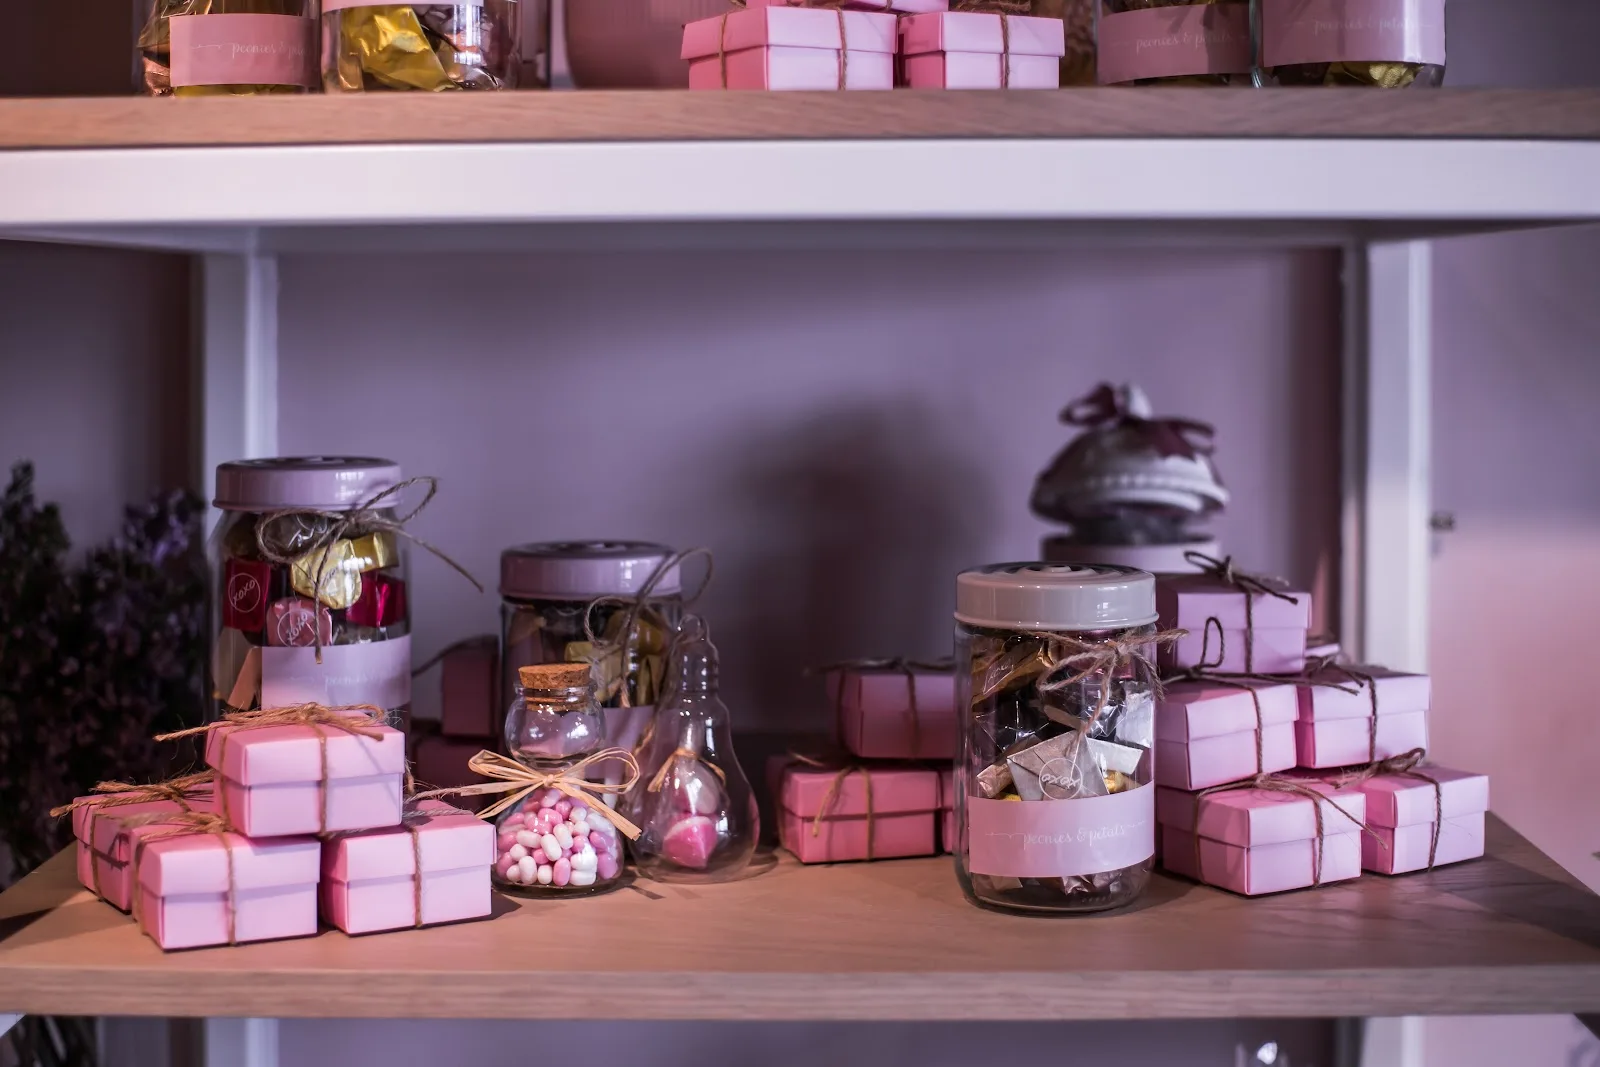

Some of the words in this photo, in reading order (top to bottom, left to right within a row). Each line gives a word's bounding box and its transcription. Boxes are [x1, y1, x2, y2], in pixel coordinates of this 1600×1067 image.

[231, 42, 277, 59] peonies
[1136, 35, 1180, 56] peonies
[233, 579, 256, 606] xoxo
[1023, 831, 1072, 850] peonies
[1076, 827, 1087, 843] &
[1089, 823, 1125, 847] petals
